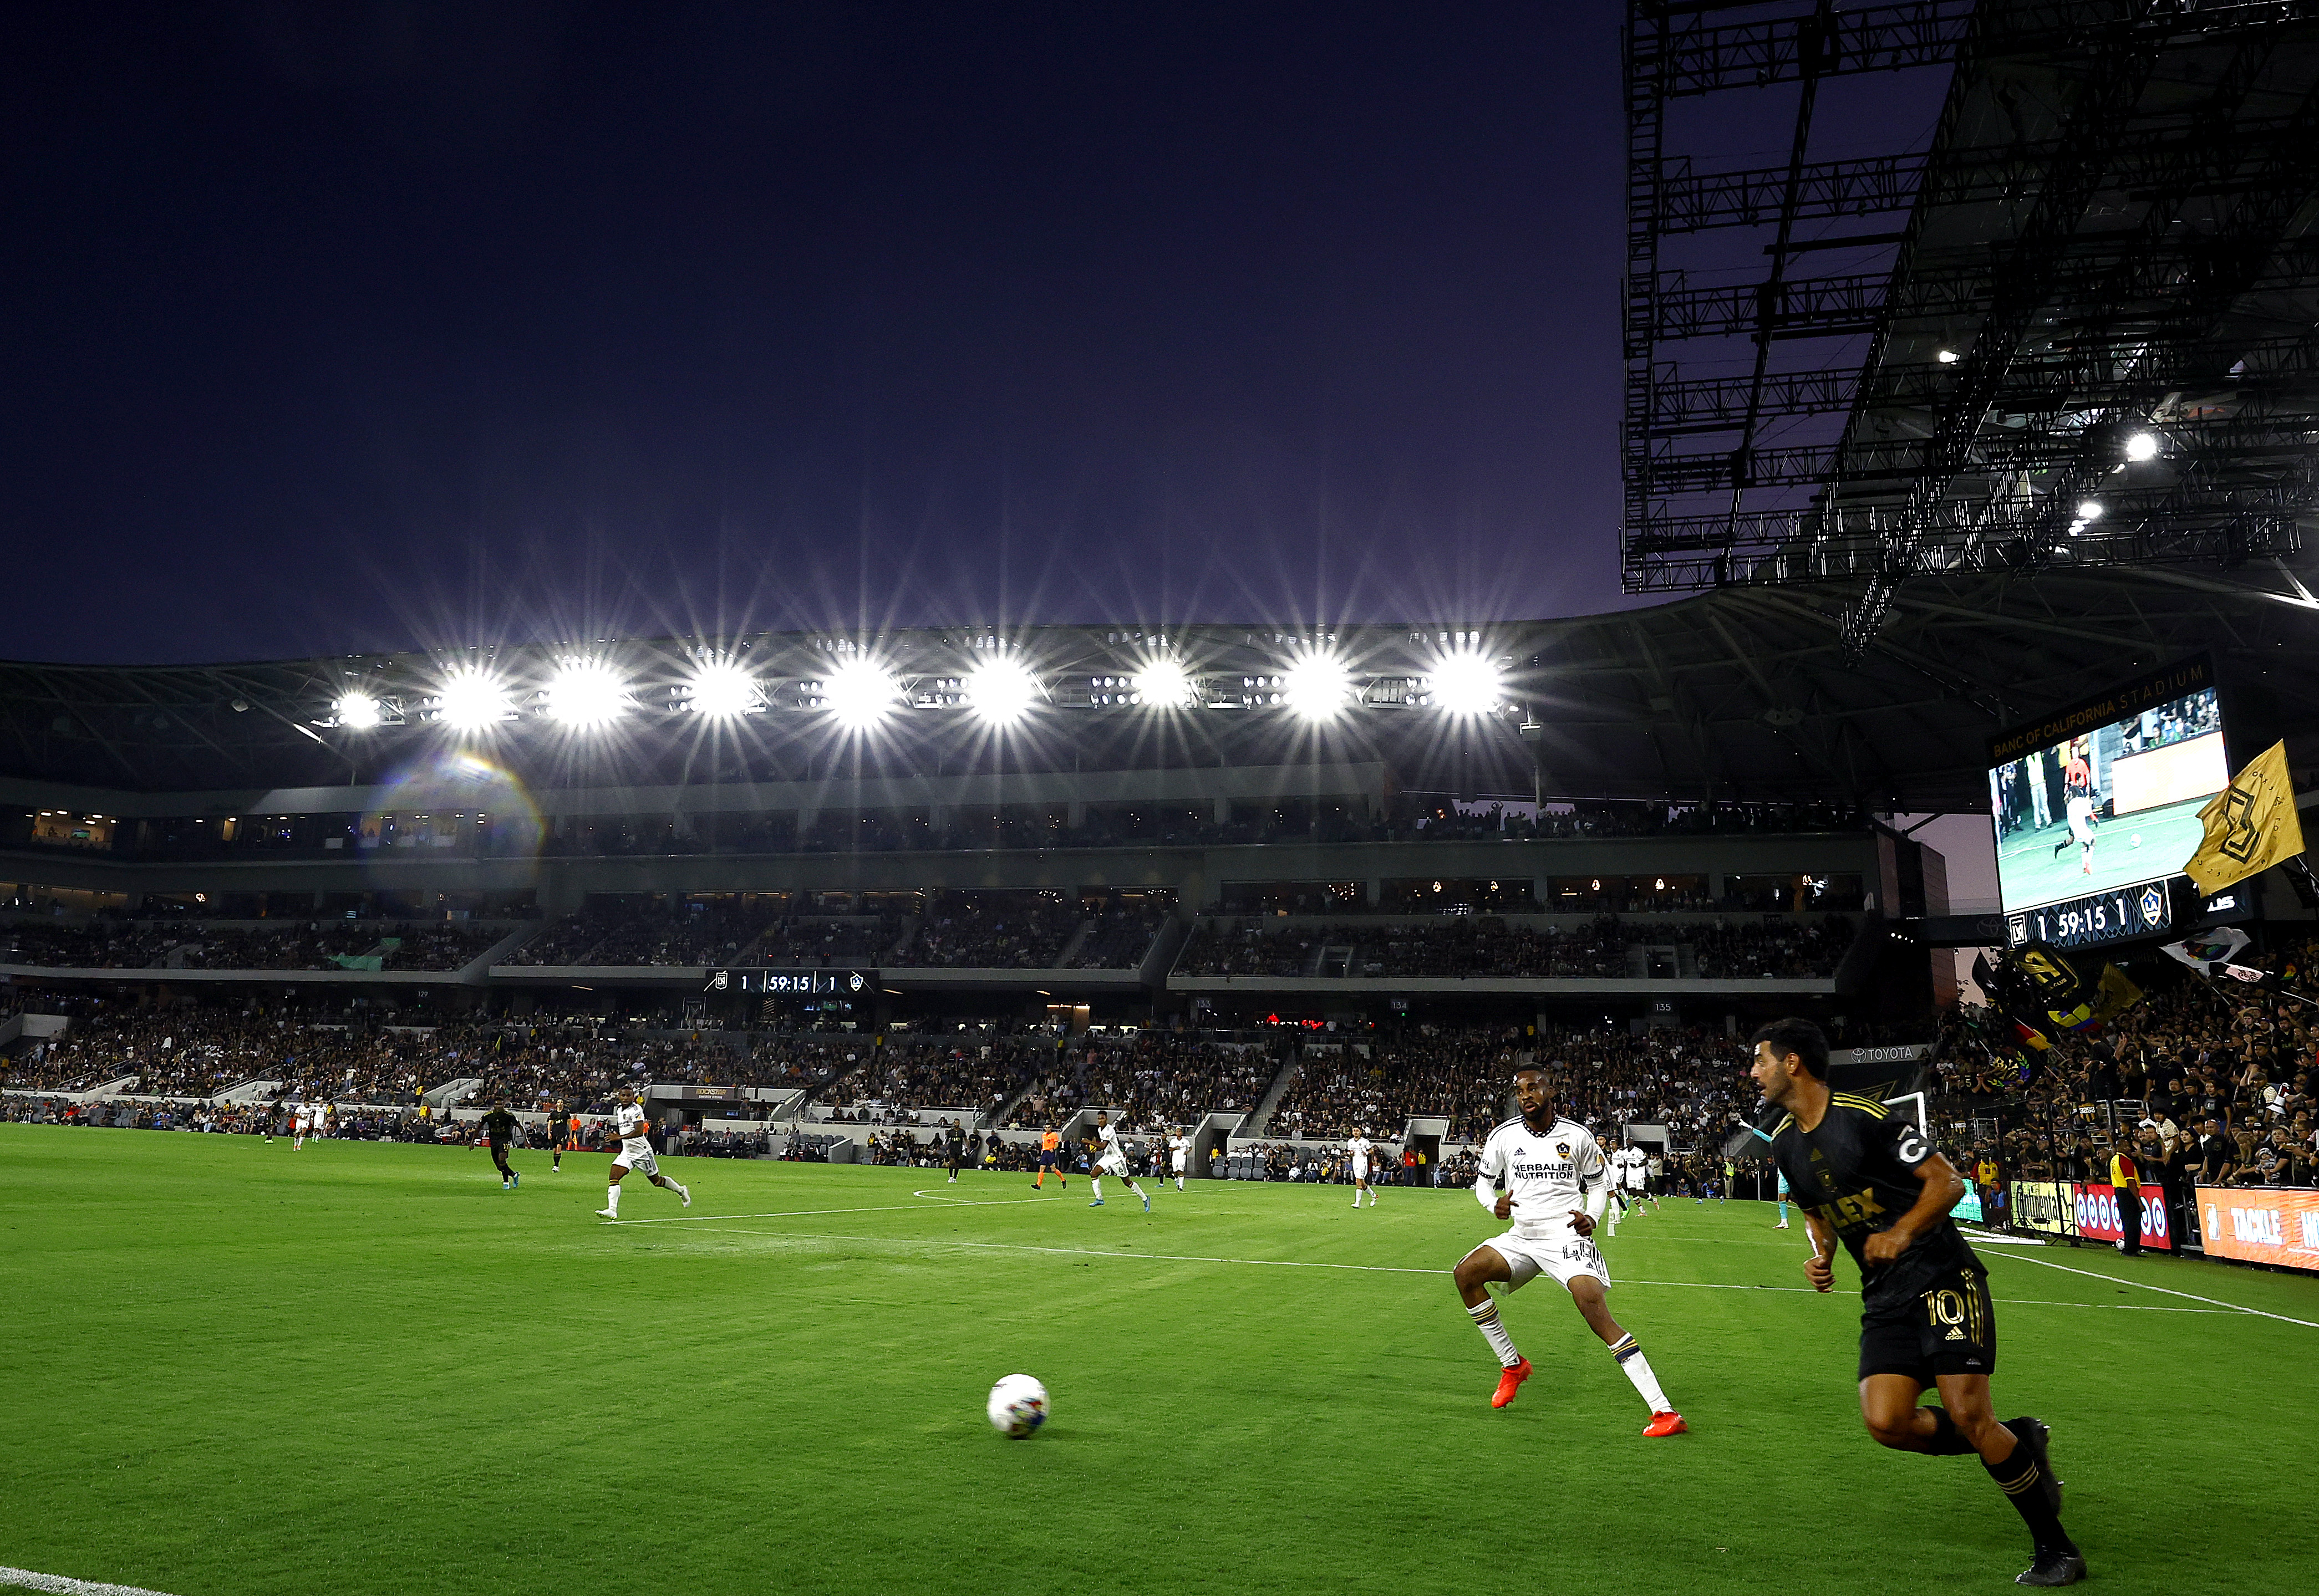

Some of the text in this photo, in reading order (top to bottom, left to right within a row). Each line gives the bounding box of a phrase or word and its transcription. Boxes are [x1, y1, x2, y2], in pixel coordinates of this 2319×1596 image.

[1993, 665, 2204, 758] BANC OF CALIFORNIA STADIUM
[2037, 898, 2126, 941] 1 59:15 1
[742, 976, 835, 991] 1 59:15 1
[1655, 1003, 1671, 1011] 135
[1868, 1047, 1913, 1060] TOYOTA
[1898, 1138, 1928, 1163] C
[1513, 1164, 1574, 1172] HERBALIFE
[2017, 1184, 2062, 1221] Continenta
[2230, 1207, 2284, 1245] TACKLE
[1920, 1289, 1965, 1326] 10
